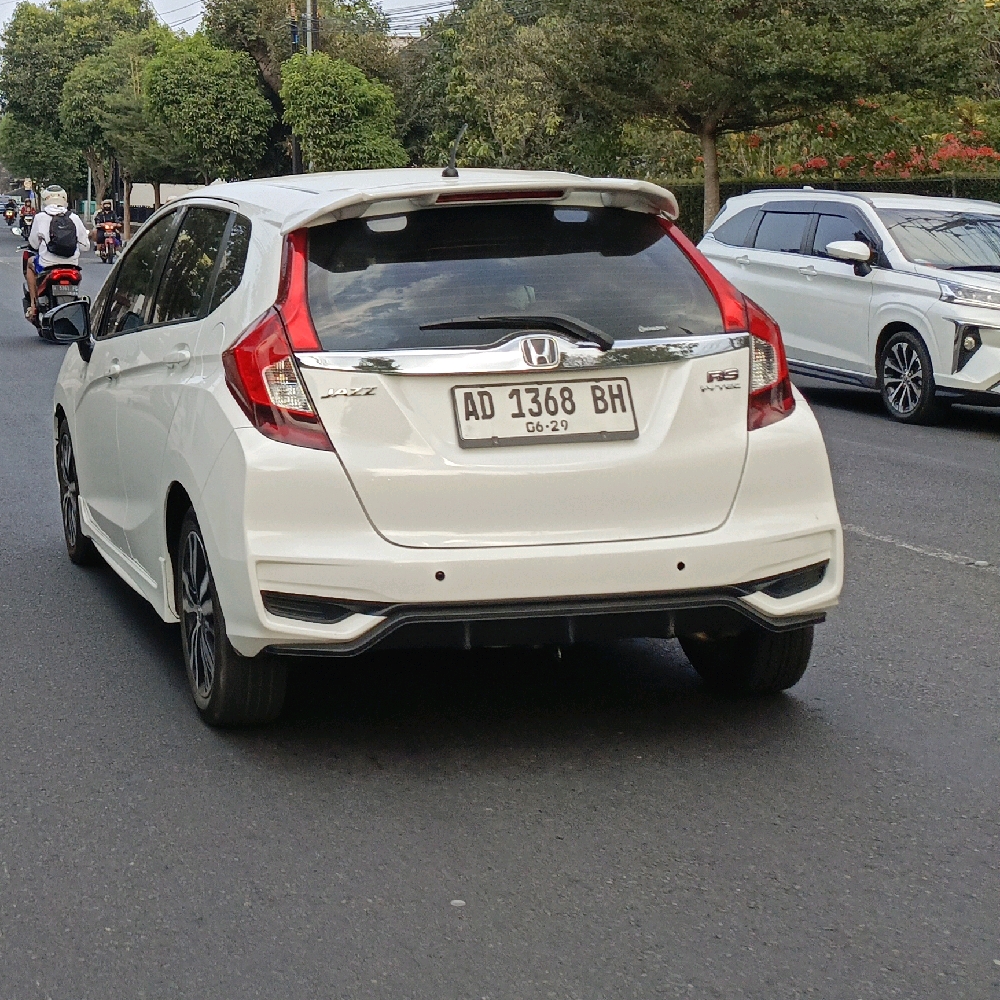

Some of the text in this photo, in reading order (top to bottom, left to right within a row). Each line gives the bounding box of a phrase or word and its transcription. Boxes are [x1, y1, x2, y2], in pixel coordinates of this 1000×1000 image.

[706, 368, 739, 383] RS
[320, 386, 378, 399] JAZZ
[463, 383, 627, 421] AD 1368 BH
